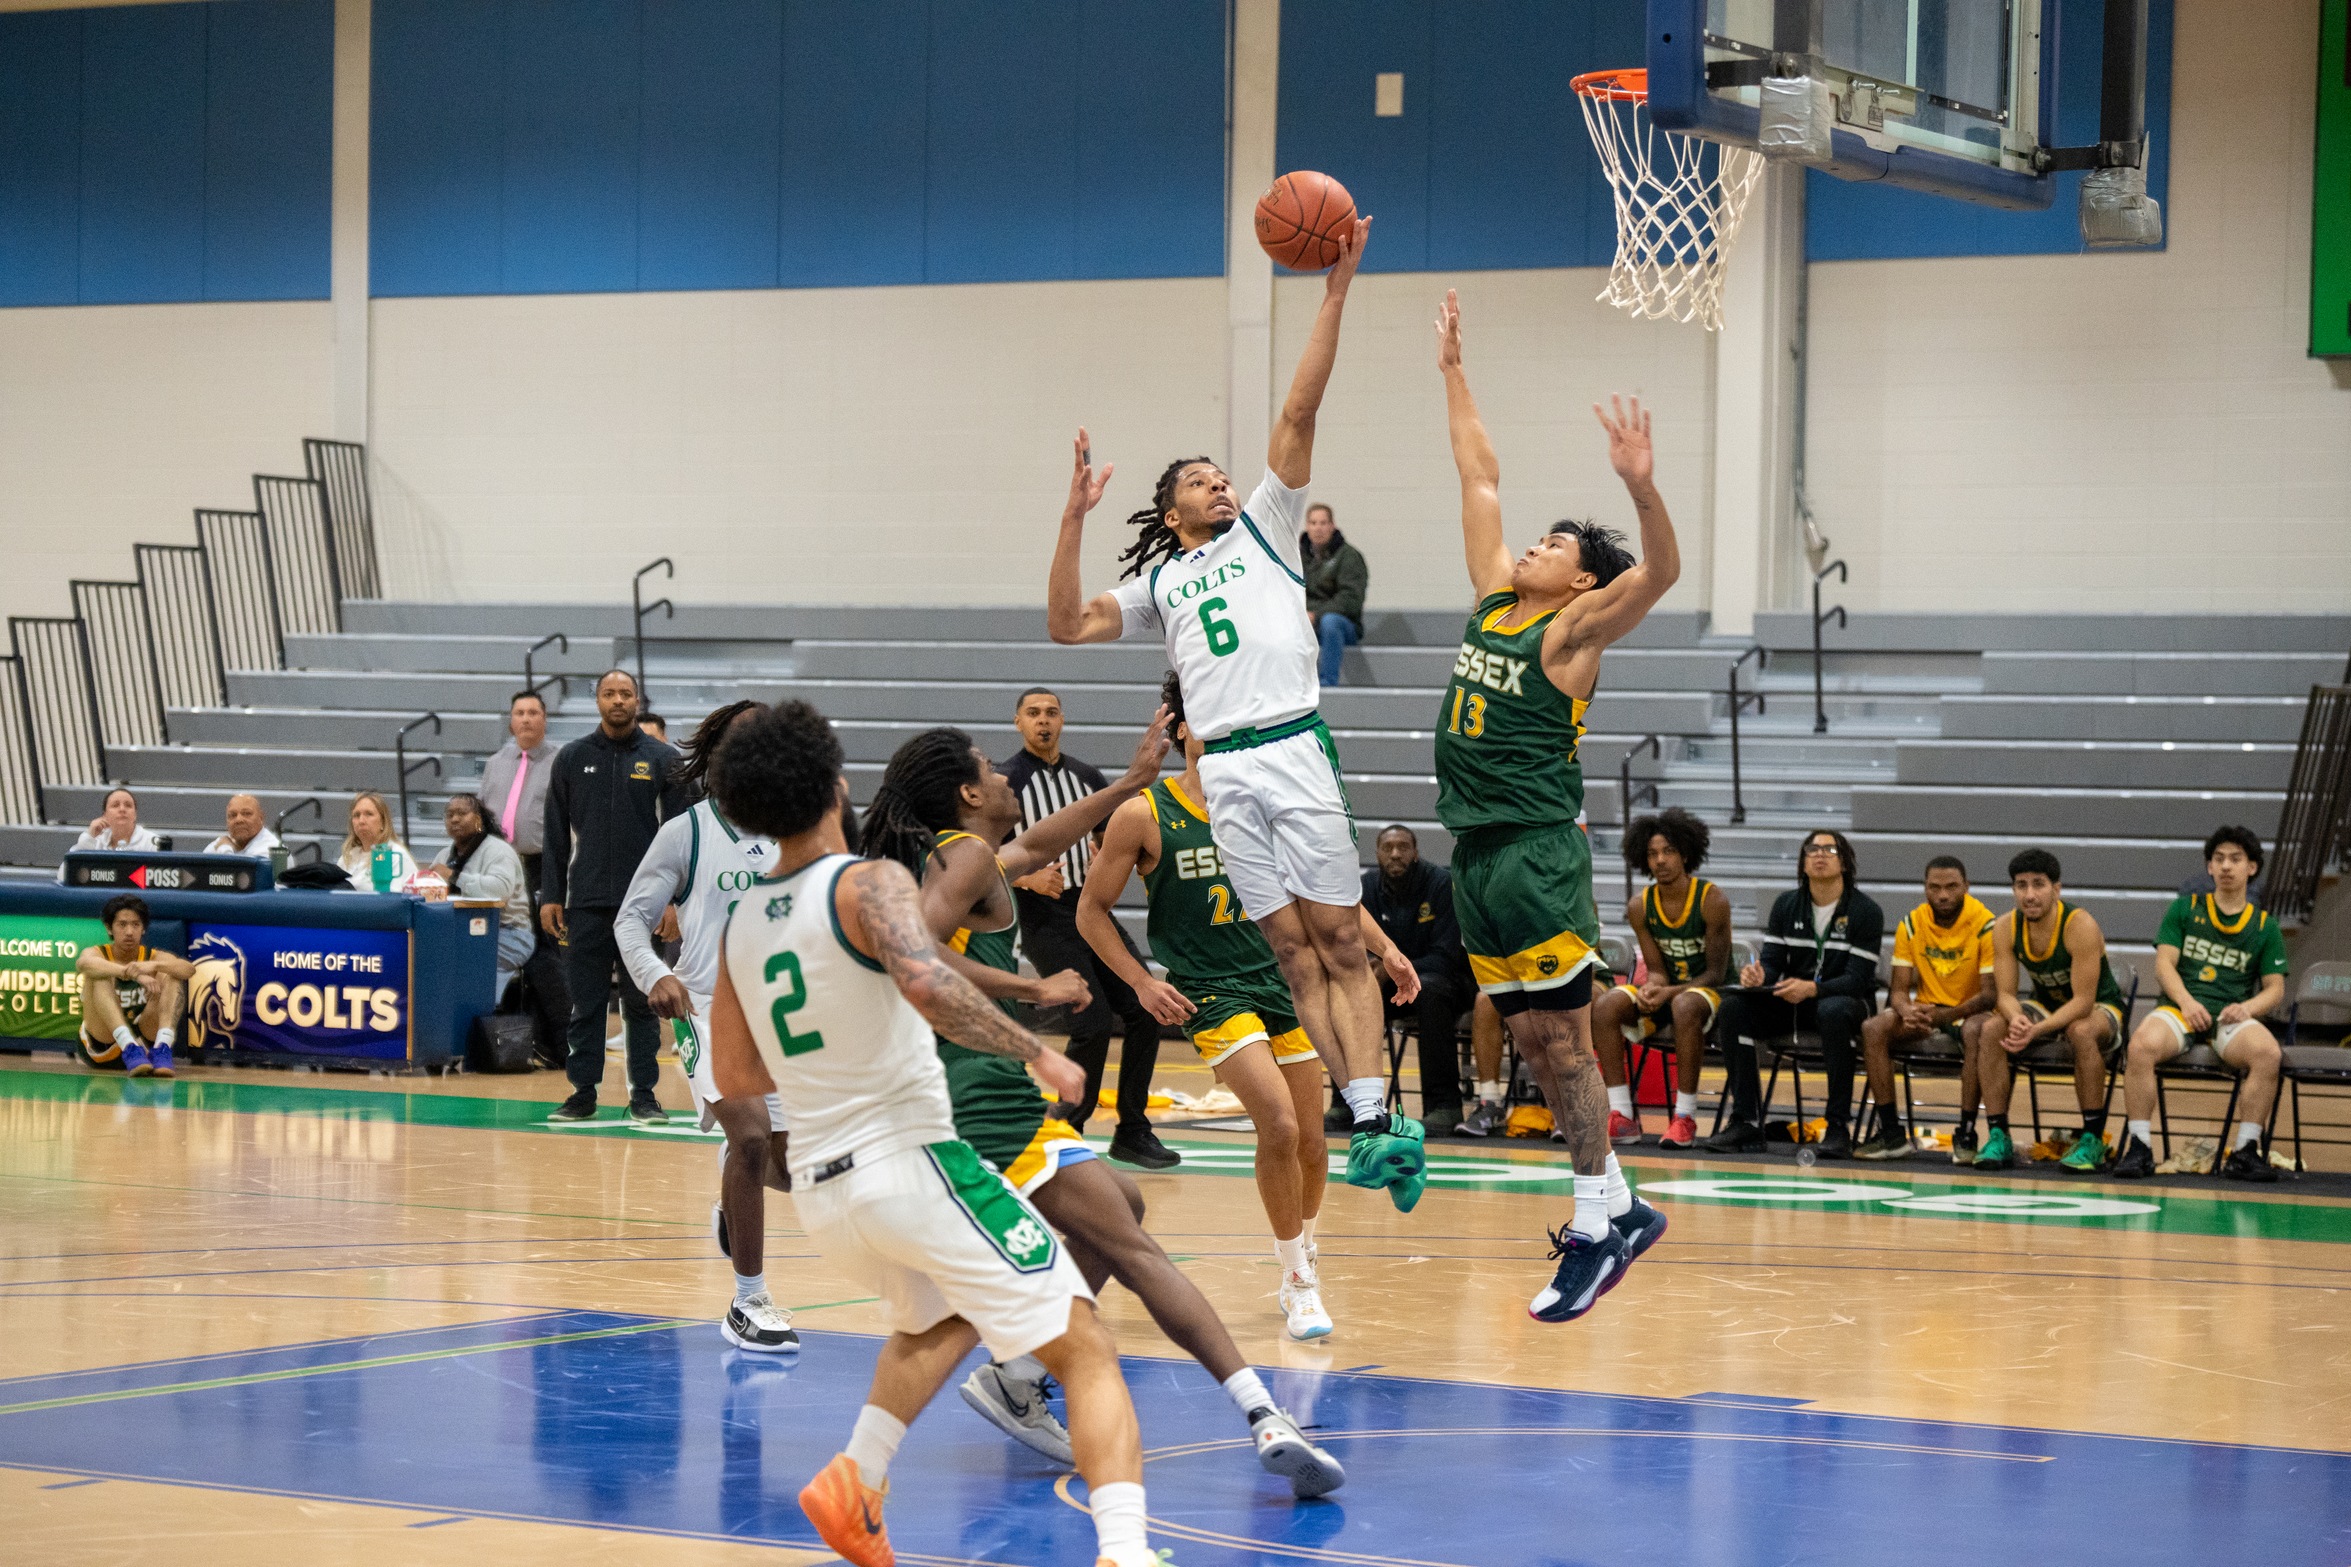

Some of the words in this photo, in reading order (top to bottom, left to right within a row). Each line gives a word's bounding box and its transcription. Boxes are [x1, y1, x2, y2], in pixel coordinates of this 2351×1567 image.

[1167, 557, 1246, 608] COLTS
[1198, 596, 1240, 657] 6
[1453, 641, 1530, 697] SSEX
[1447, 685, 1488, 739] 13
[91, 870, 116, 882] BONUS
[145, 868, 180, 888] POSS
[208, 873, 234, 886] BONUS
[717, 870, 768, 892] CO
[1208, 884, 1250, 926] 2
[55, 941, 78, 959] TO
[273, 951, 322, 970] HOME
[324, 952, 349, 971] OF
[350, 955, 383, 973] THE
[2182, 934, 2252, 974] ESSEX
[255, 981, 399, 1032] COLTS
[764, 950, 825, 1058] 2
